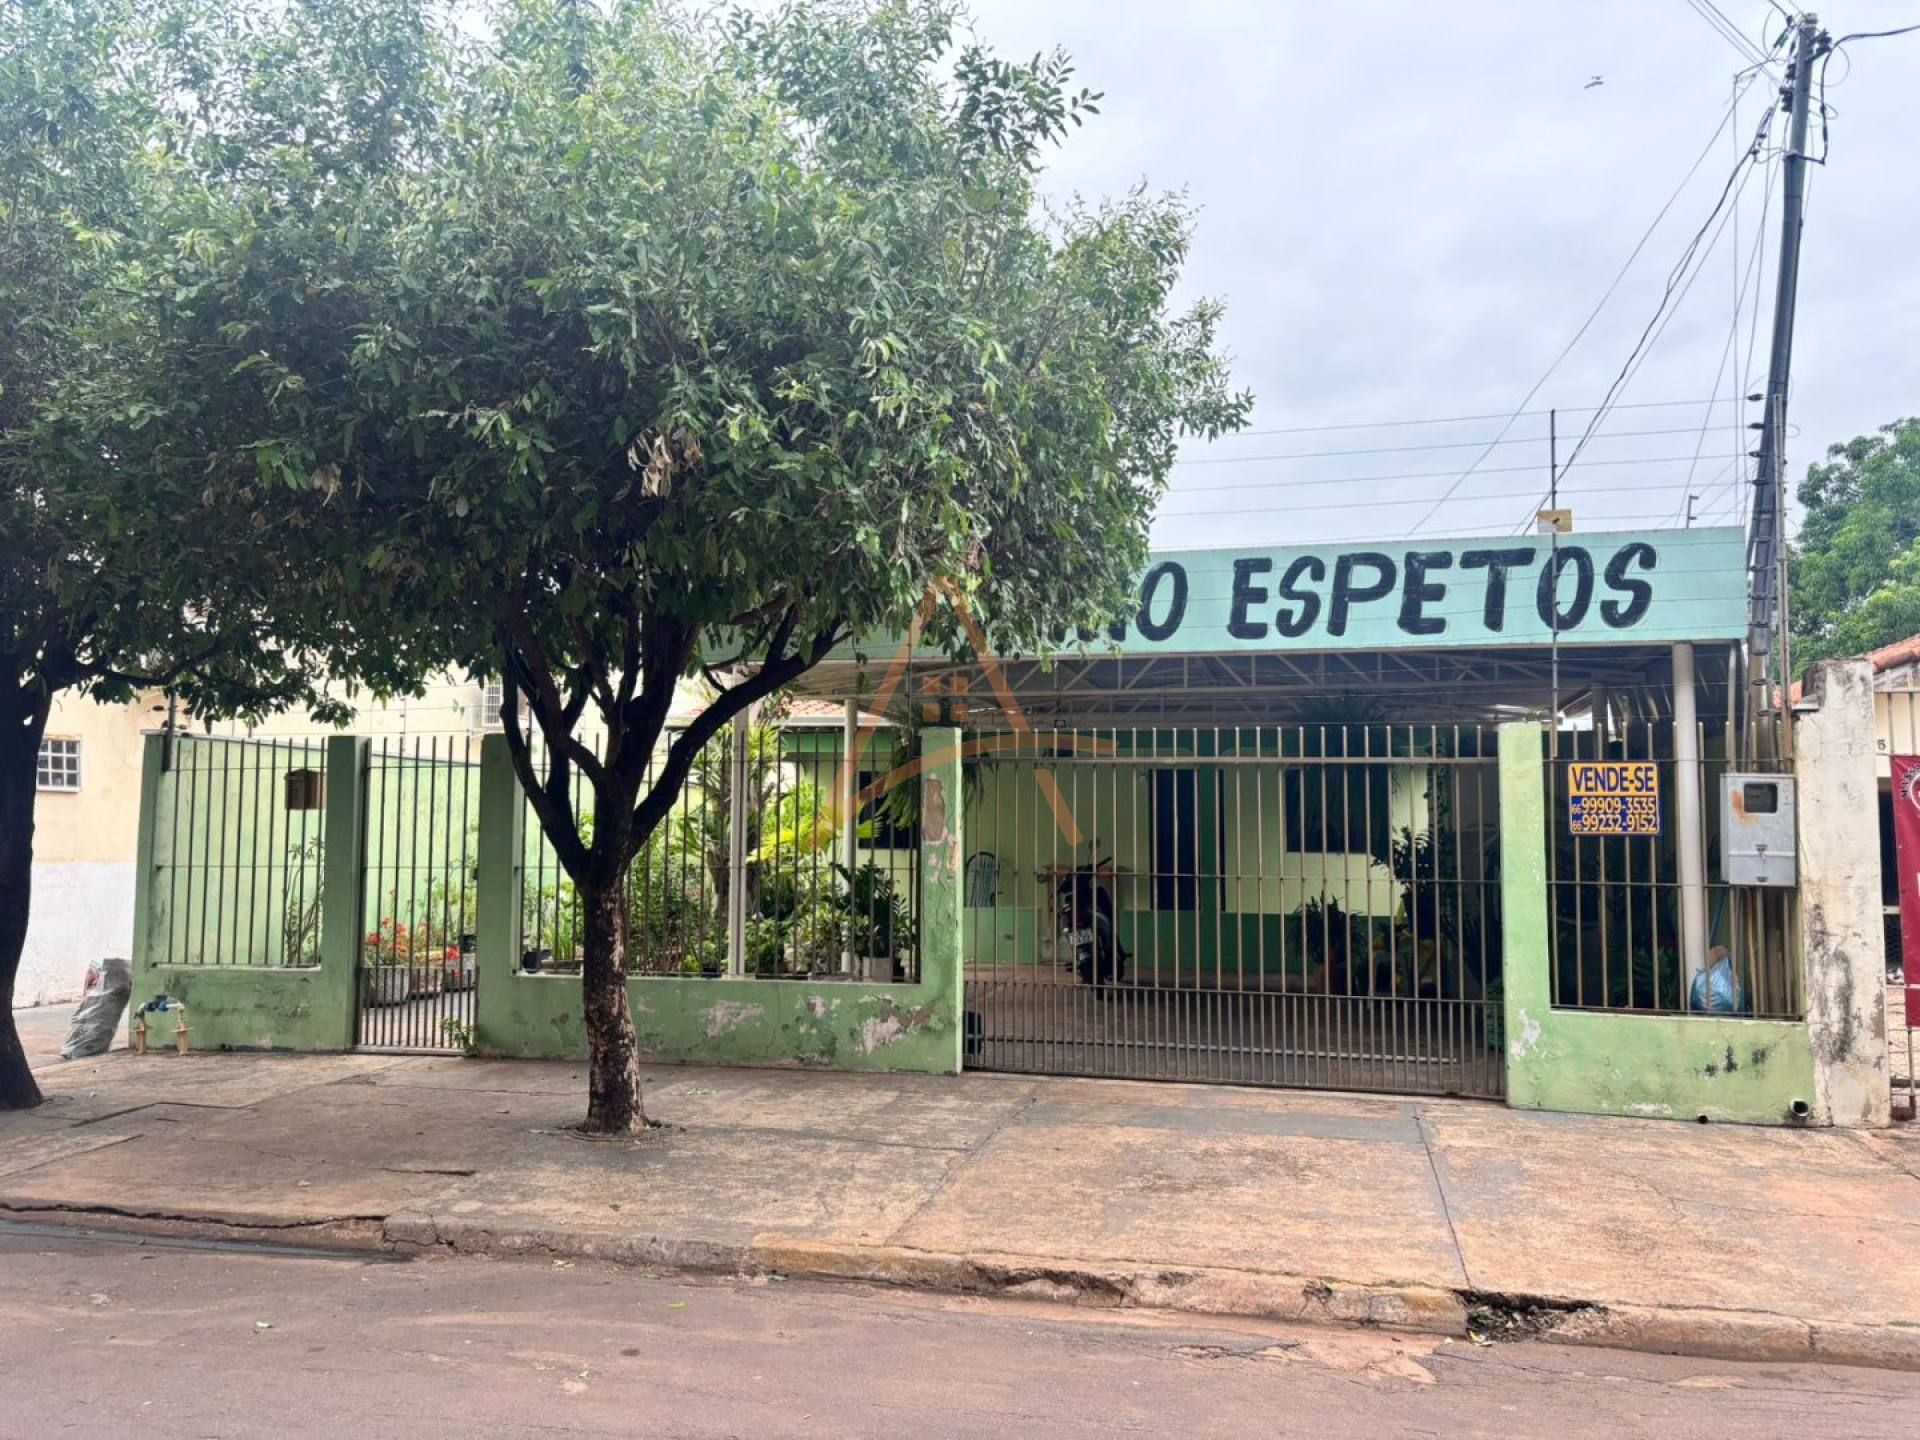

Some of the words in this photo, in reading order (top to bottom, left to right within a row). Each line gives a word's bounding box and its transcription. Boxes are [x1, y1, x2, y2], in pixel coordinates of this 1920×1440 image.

[1227, 542, 1657, 639] ESPETOS
[1572, 766, 1654, 792] VENDE-SE
[1582, 797, 1656, 814] 99909-3535
